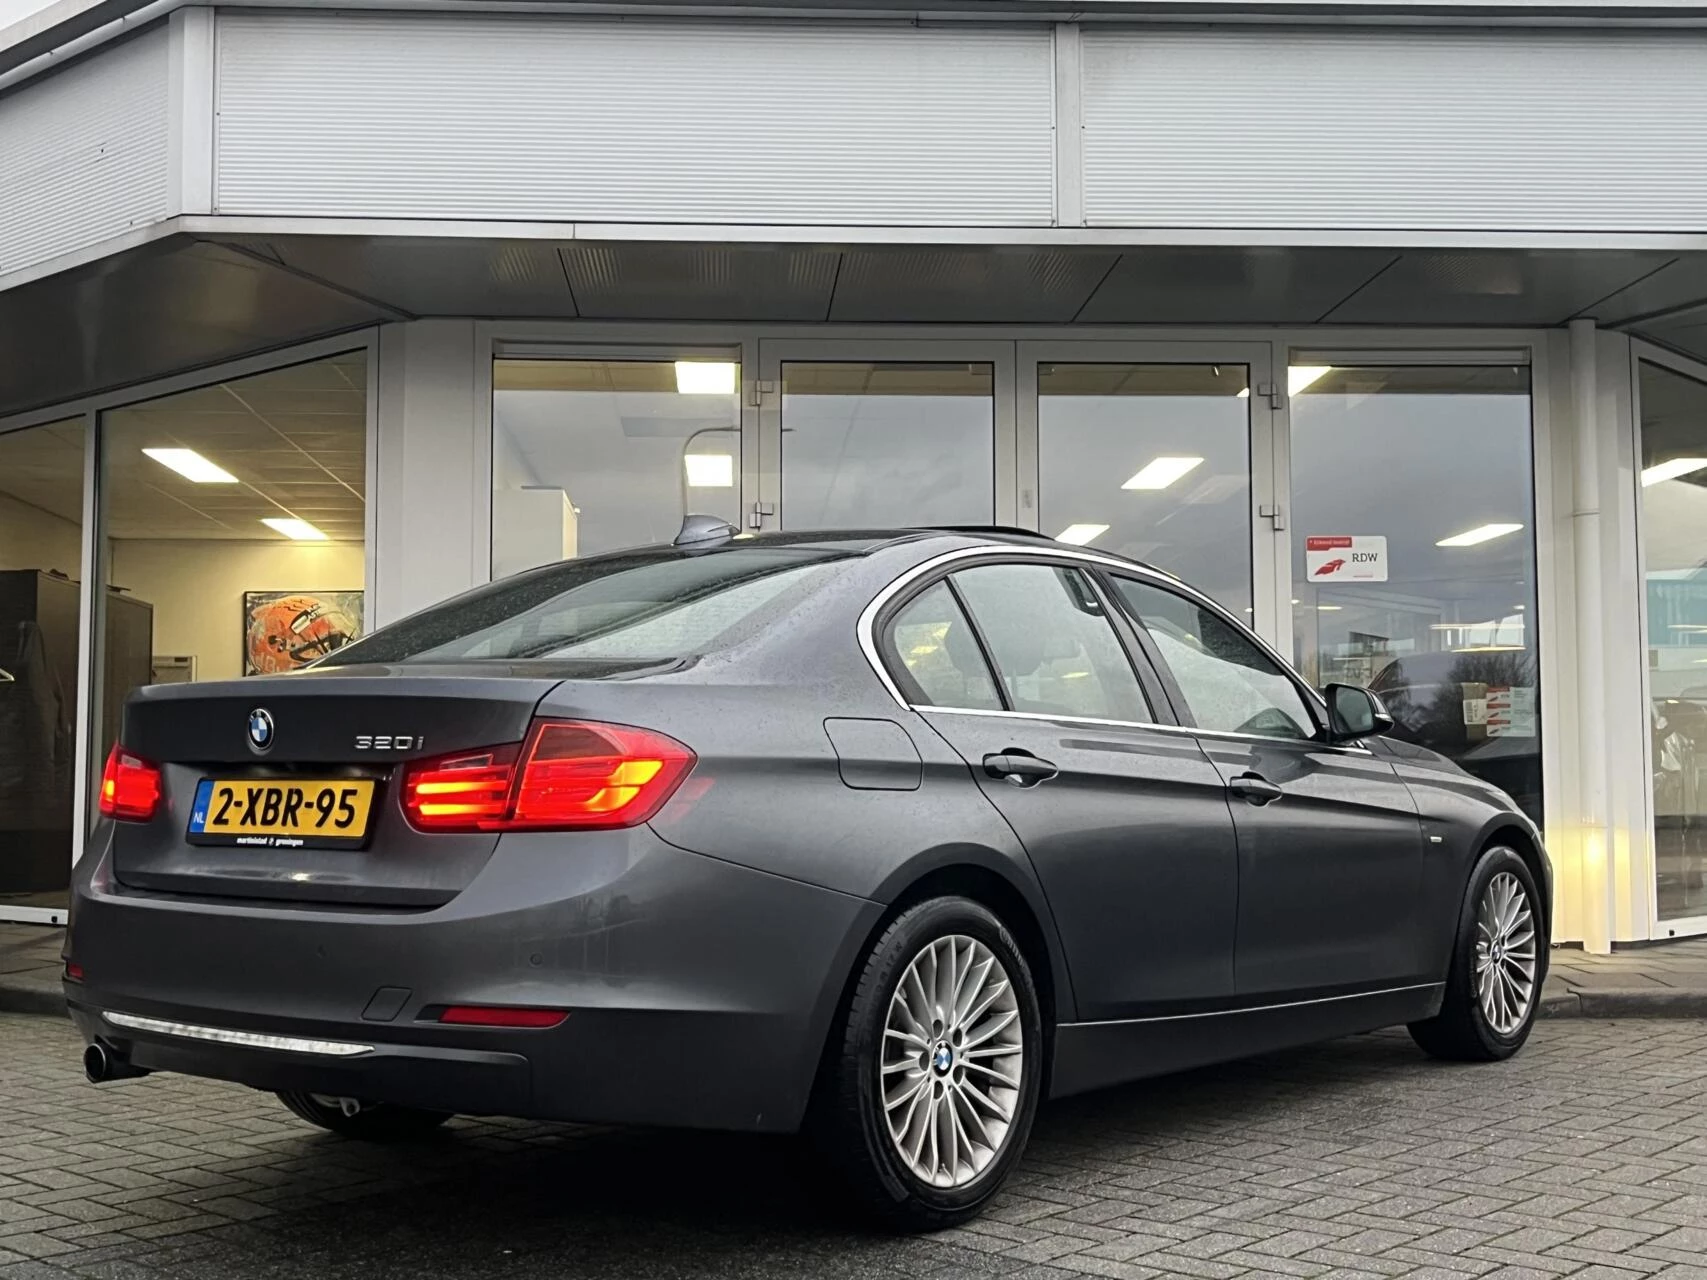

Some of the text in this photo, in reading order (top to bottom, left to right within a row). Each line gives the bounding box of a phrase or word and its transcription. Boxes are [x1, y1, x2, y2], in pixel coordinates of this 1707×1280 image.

[1352, 553, 1378, 562] RDW
[355, 735, 424, 750] 320i
[213, 787, 358, 828] 2-XBR-95
[192, 811, 205, 824] NL
